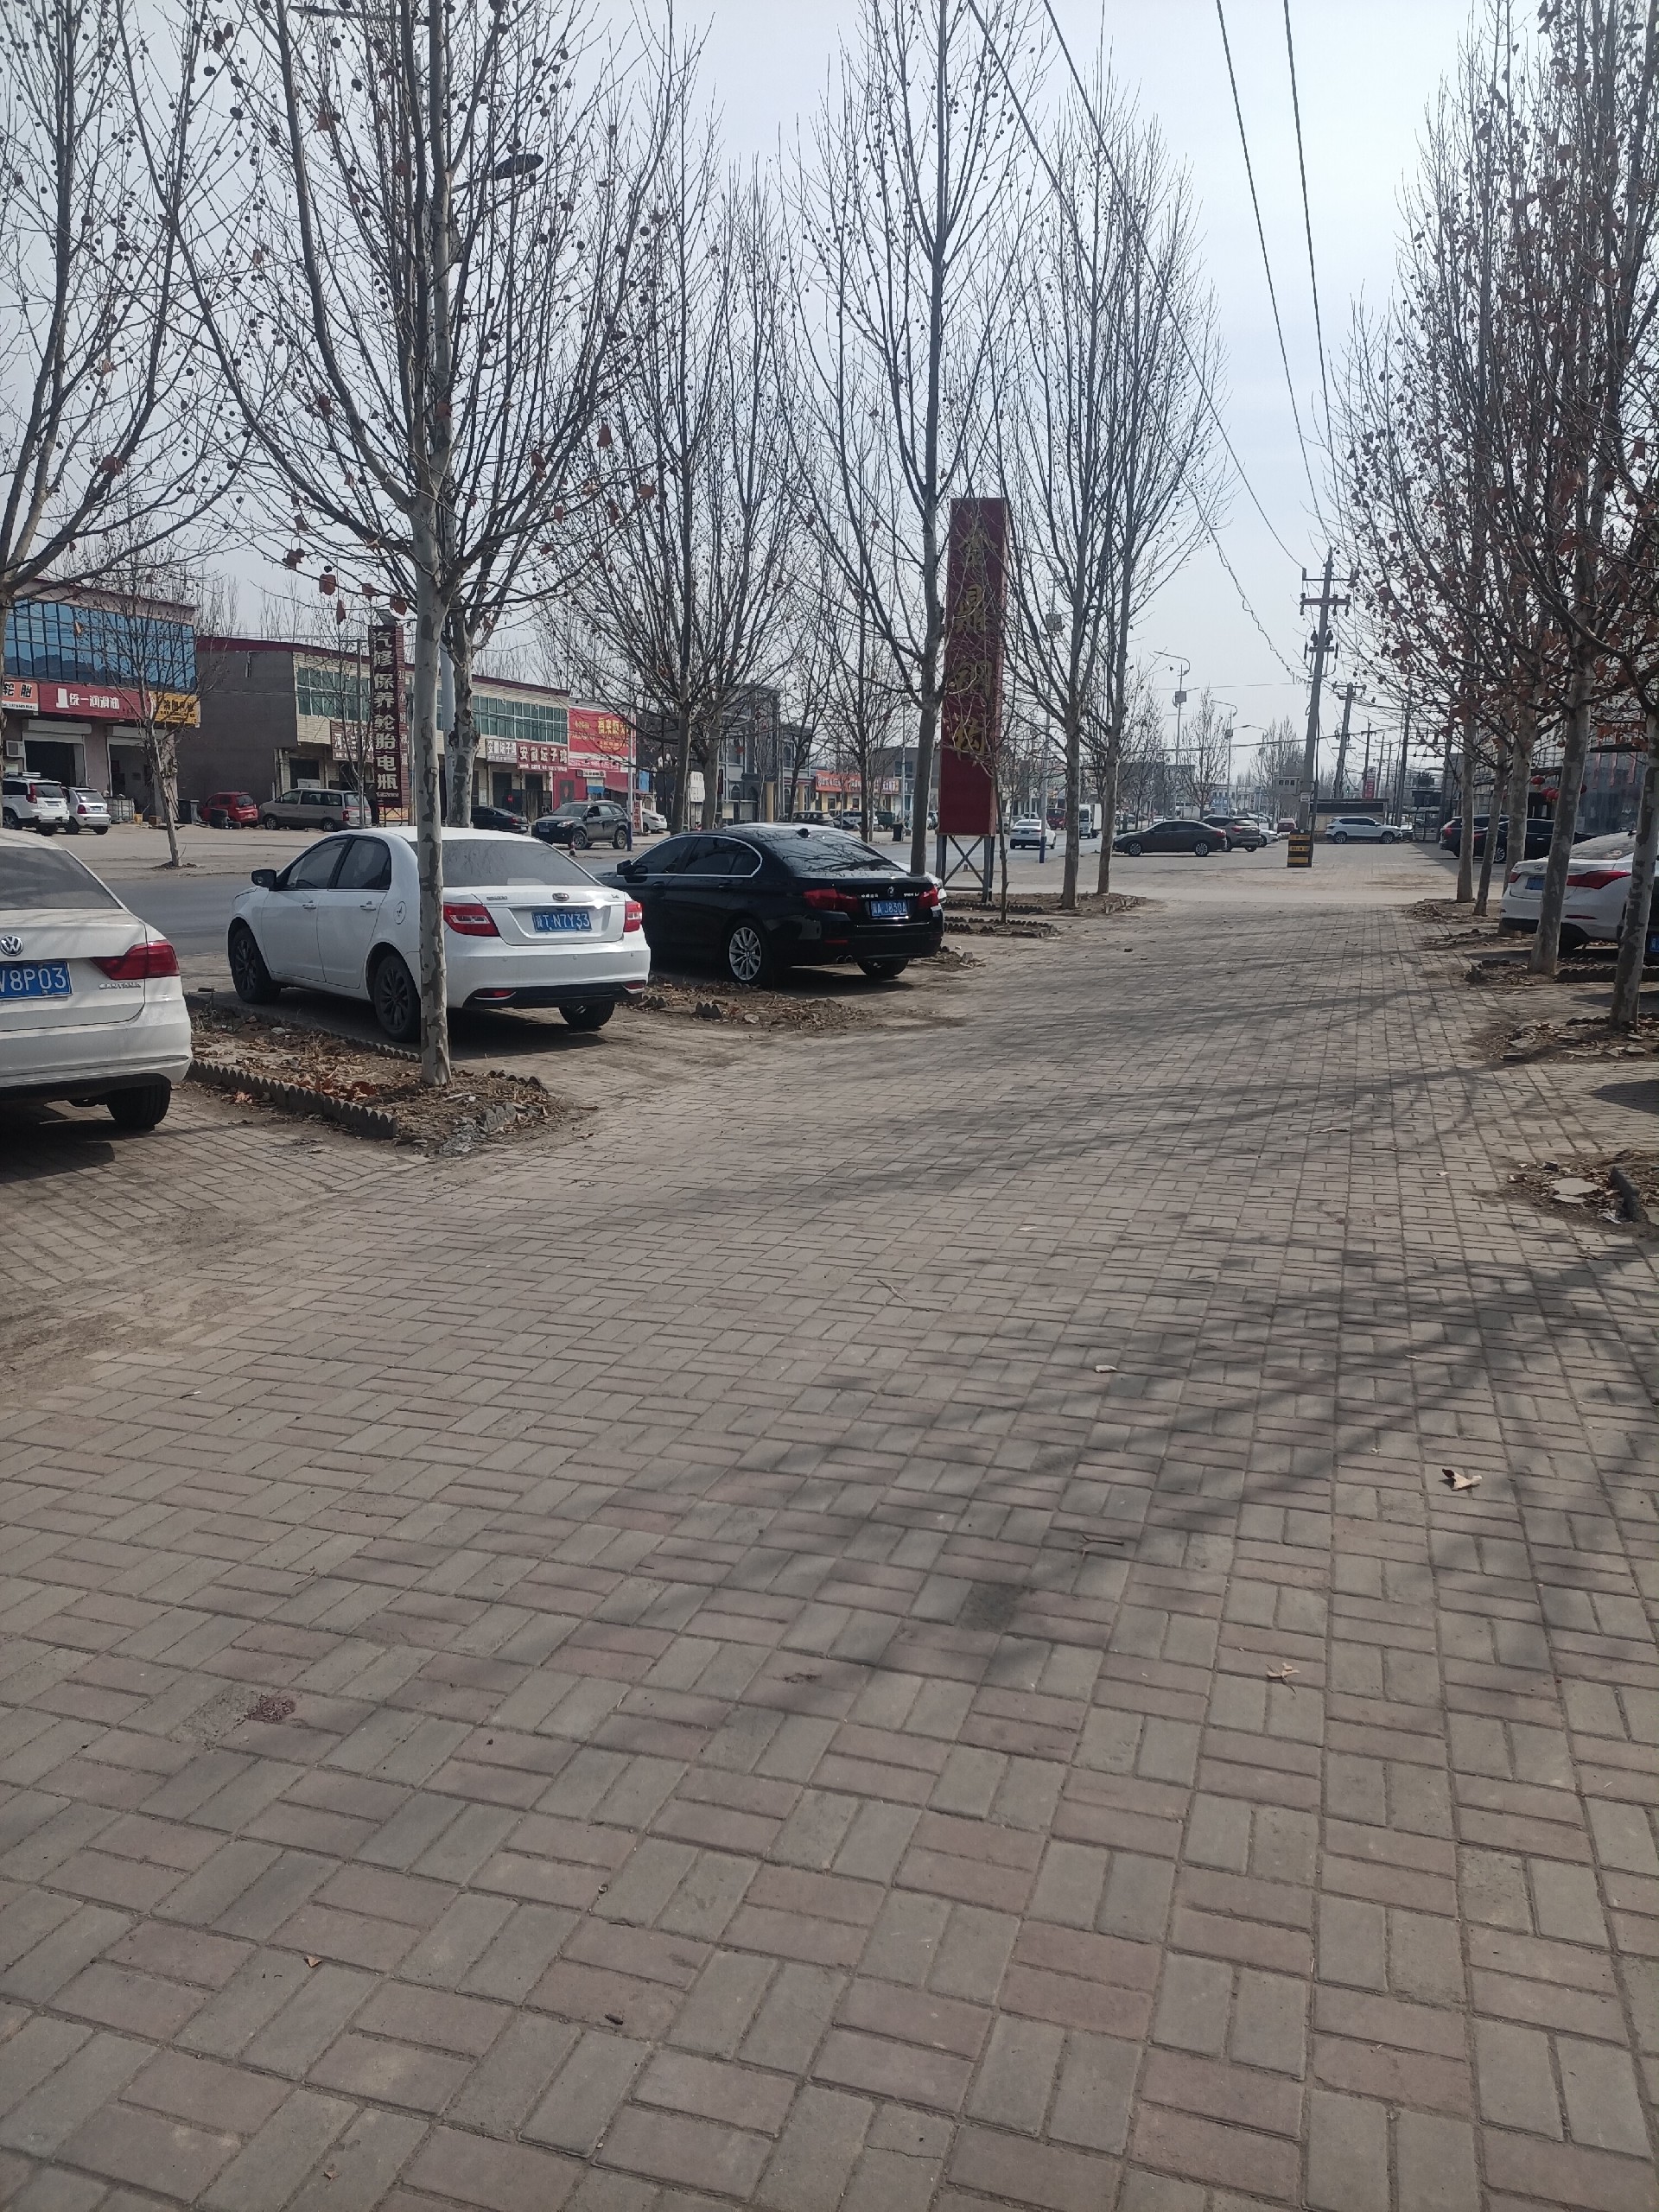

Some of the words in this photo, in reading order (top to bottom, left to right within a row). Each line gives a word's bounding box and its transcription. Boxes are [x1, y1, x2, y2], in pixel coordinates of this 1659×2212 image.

[69, 692, 120, 709] 统一润滑油
[373, 631, 398, 790] 汽修保养轮胎电瓶
